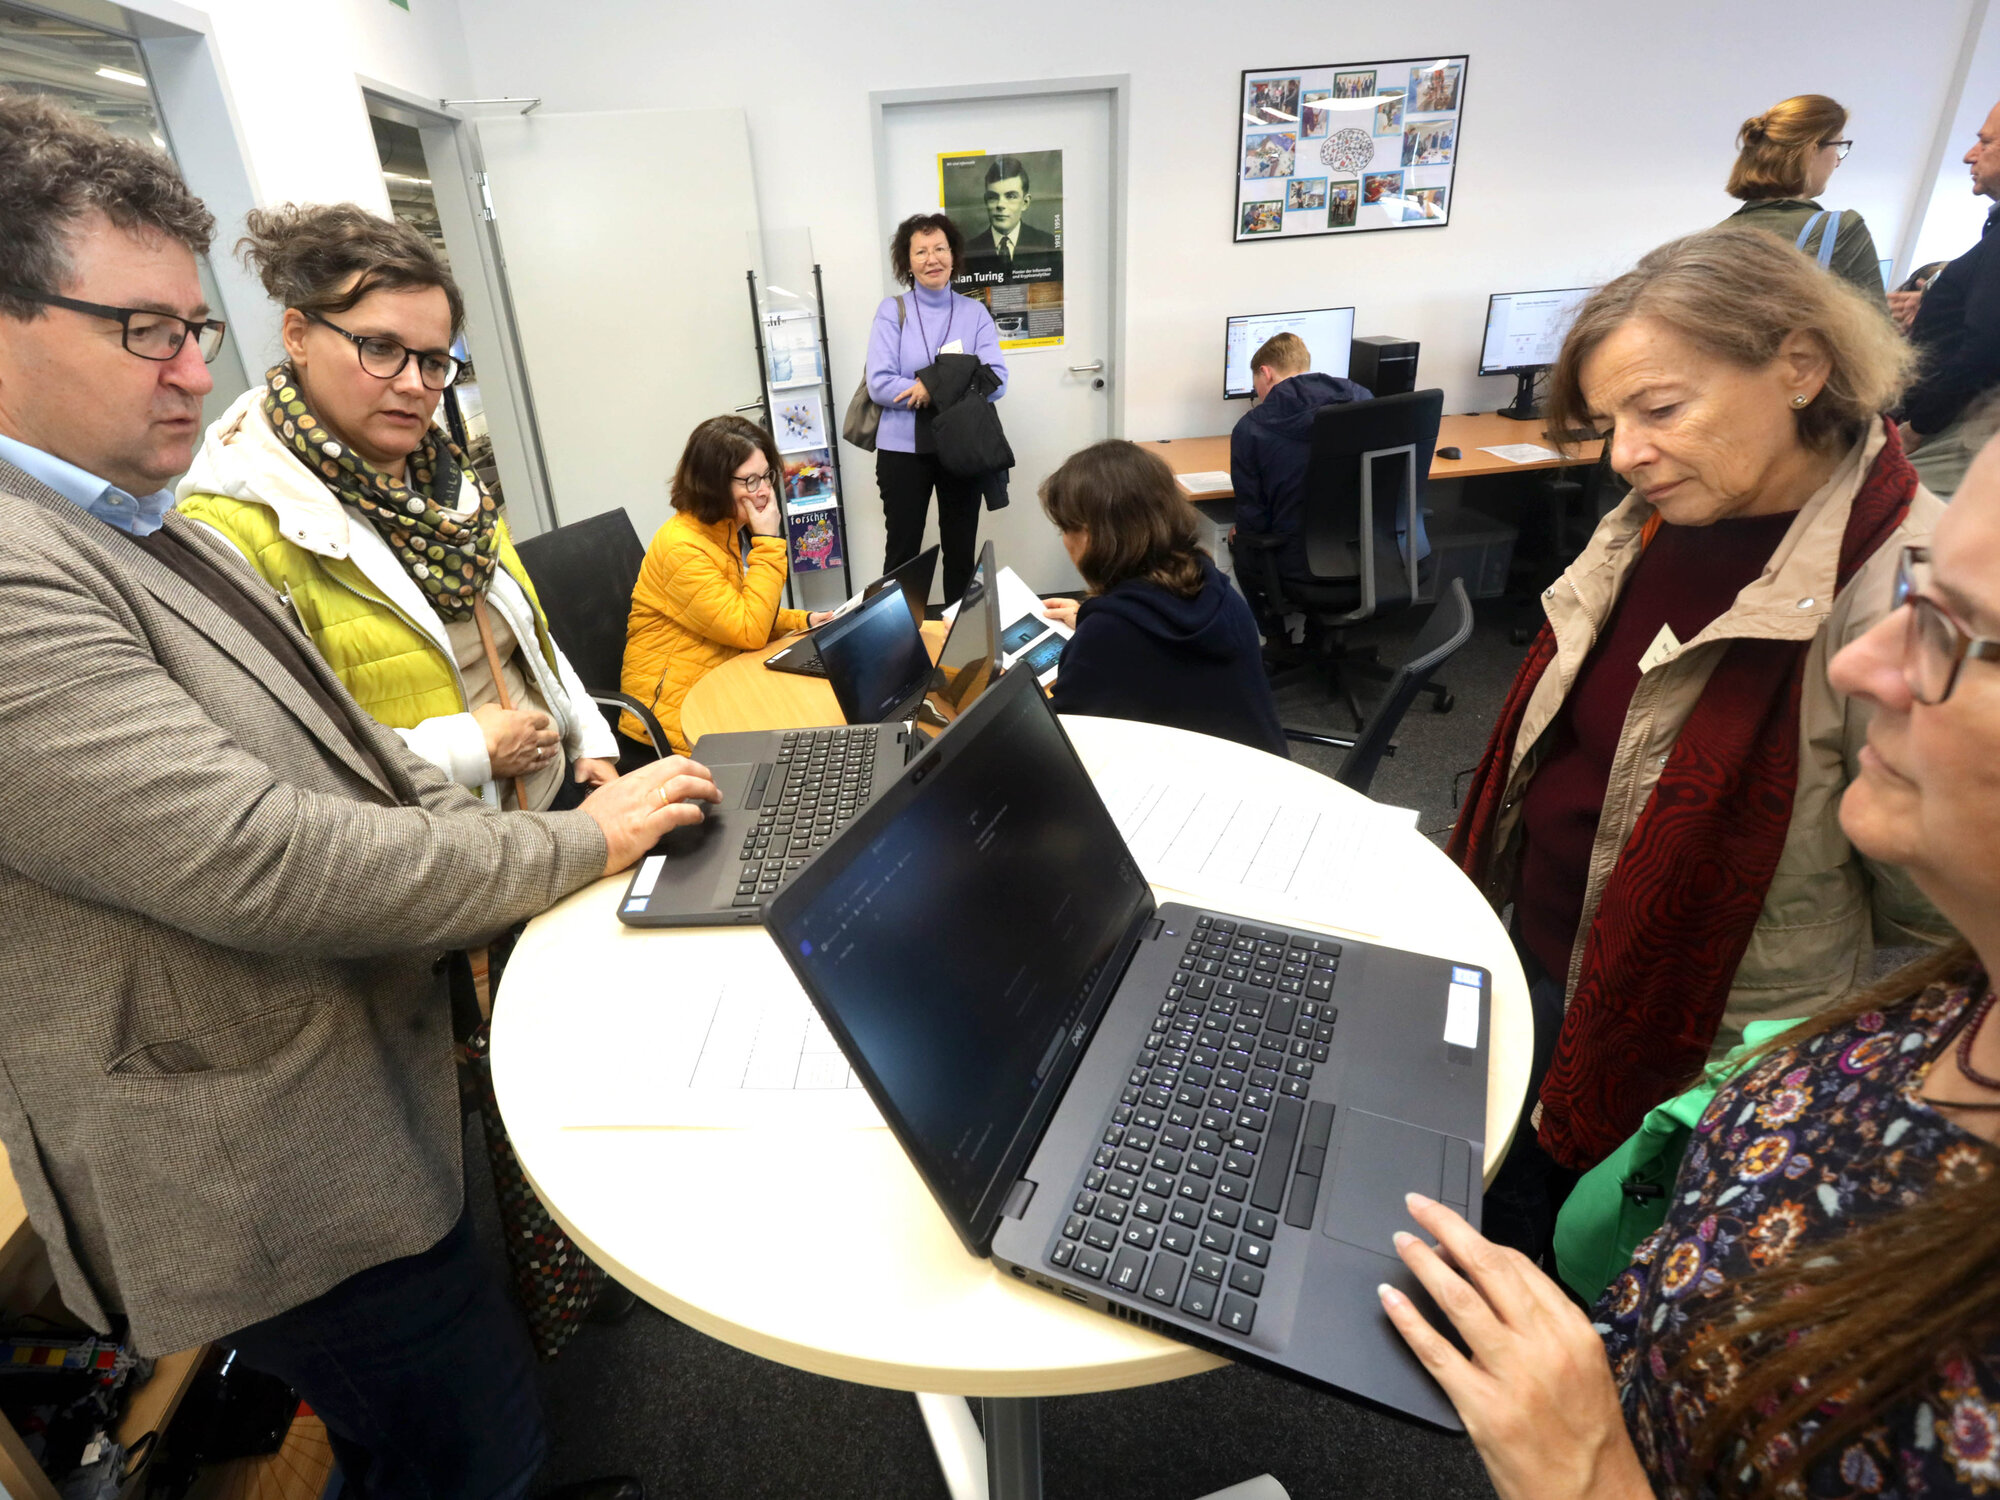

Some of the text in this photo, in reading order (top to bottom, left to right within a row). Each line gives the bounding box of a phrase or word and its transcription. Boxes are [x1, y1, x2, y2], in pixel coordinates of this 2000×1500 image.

[974, 271, 1004, 283] Turing
[790, 511, 829, 526] forscher
[1071, 1022, 1087, 1047] DELL
